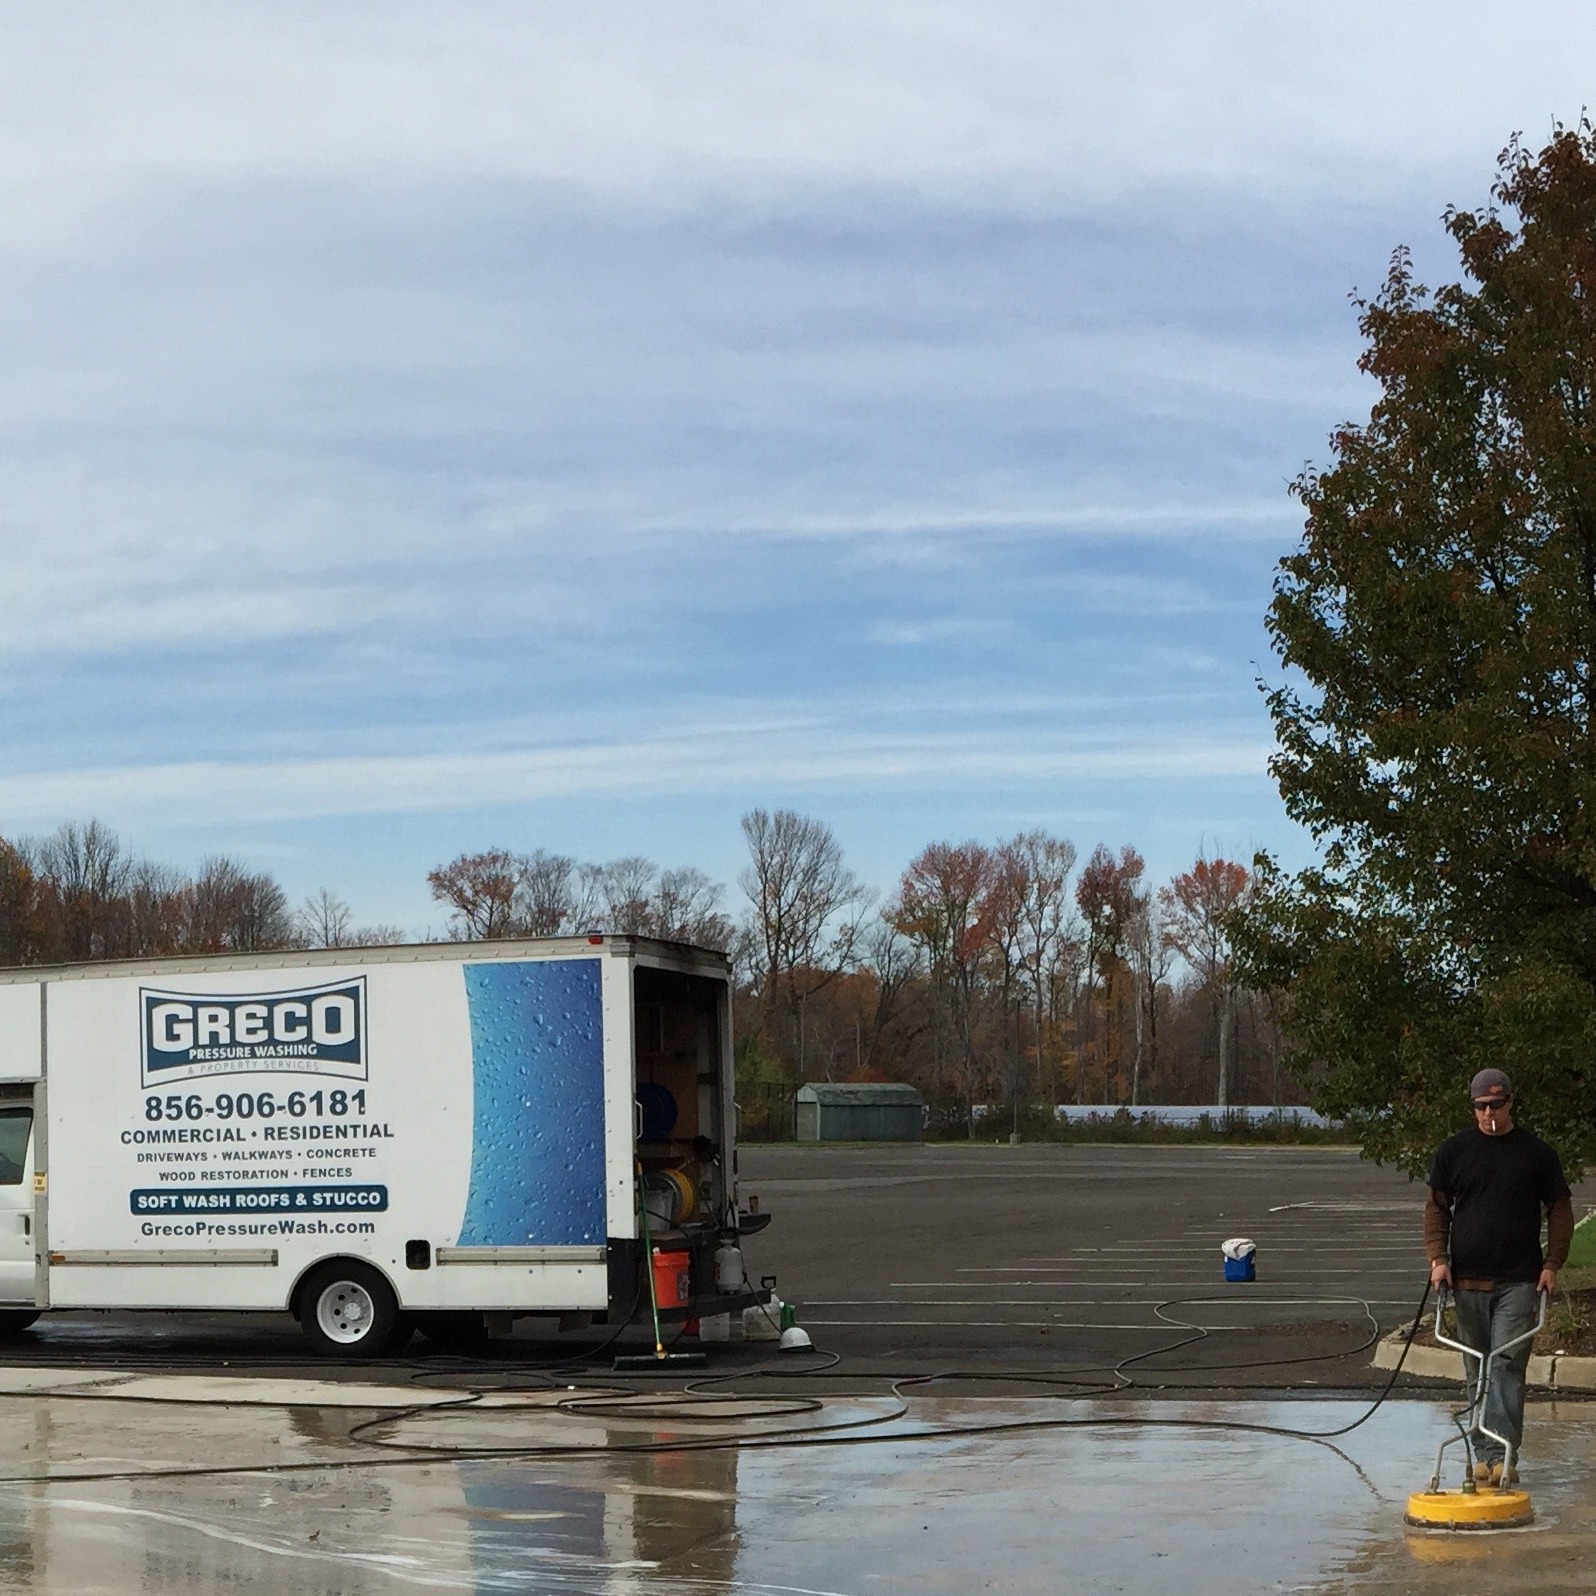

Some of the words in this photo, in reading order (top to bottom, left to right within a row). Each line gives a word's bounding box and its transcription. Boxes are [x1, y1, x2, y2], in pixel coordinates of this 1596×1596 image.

[151, 994, 356, 1053] GRECO
[189, 1047, 251, 1060] PRESSURE
[255, 1043, 318, 1057] WASHING
[200, 1060, 258, 1073] PROPERTY
[263, 1059, 320, 1072] SERVICES
[145, 1088, 367, 1122] 856-906-6181
[120, 1128, 246, 1145] COMMERCIAL
[263, 1124, 395, 1141] RESIDENTIAL
[137, 1151, 208, 1163] DRIVEWAYS
[221, 1149, 293, 1161] WALKWAYS
[306, 1147, 377, 1159] CONCRETE
[159, 1171, 196, 1182] WOOD
[201, 1169, 289, 1180] RESTORATION
[302, 1167, 353, 1178] FENCES
[137, 1195, 179, 1209] SOFT
[183, 1194, 231, 1208] WASH
[235, 1193, 290, 1207] ROOFS
[295, 1192, 307, 1206] &
[312, 1191, 381, 1206] STUCCO
[140, 1219, 375, 1236] GrecoPressureWash.com
